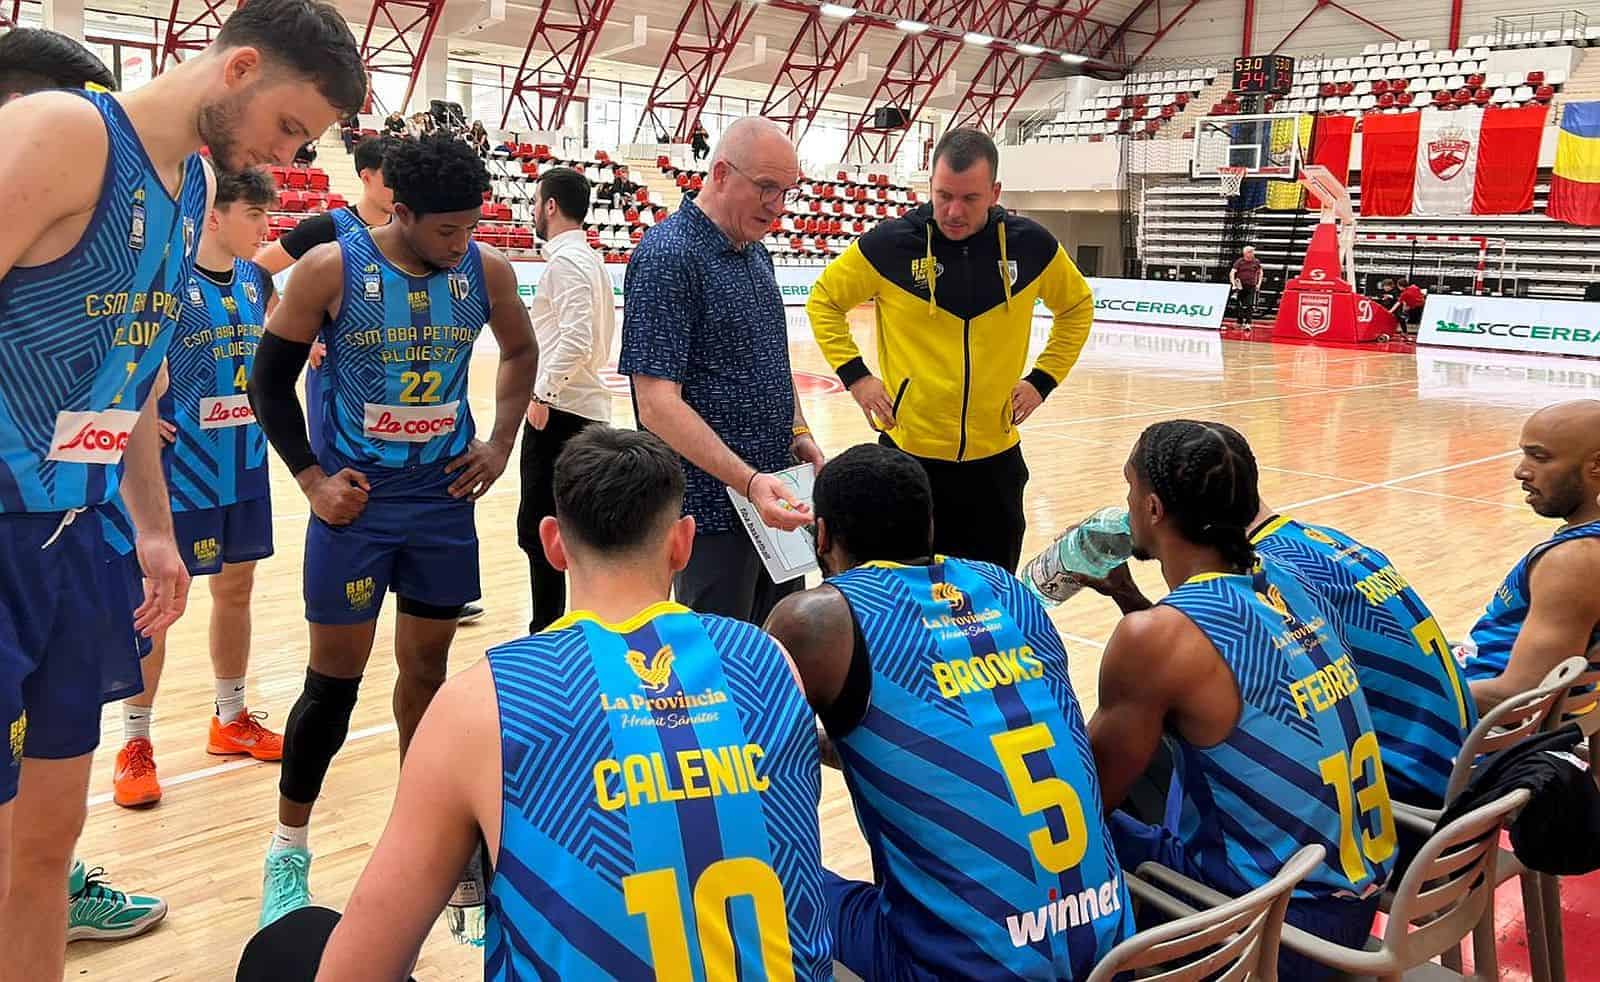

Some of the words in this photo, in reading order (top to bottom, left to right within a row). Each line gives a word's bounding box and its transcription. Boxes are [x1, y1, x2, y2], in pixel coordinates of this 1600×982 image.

[1240, 72, 1265, 90] 24
[183, 329, 213, 349] CSM
[344, 329, 381, 347] CSM
[387, 326, 418, 342] BBA
[232, 364, 249, 391] 4
[400, 371, 442, 403] 22
[368, 411, 402, 434] La
[932, 645, 1044, 699] BROOKS
[1410, 615, 1469, 731] 7
[600, 693, 630, 711] La
[630, 687, 728, 711] Provincia
[593, 743, 770, 811] CALENIC
[990, 722, 1088, 873] 5
[1318, 731, 1398, 884] 13
[622, 857, 795, 982] 10
[1006, 875, 1120, 948] winner
